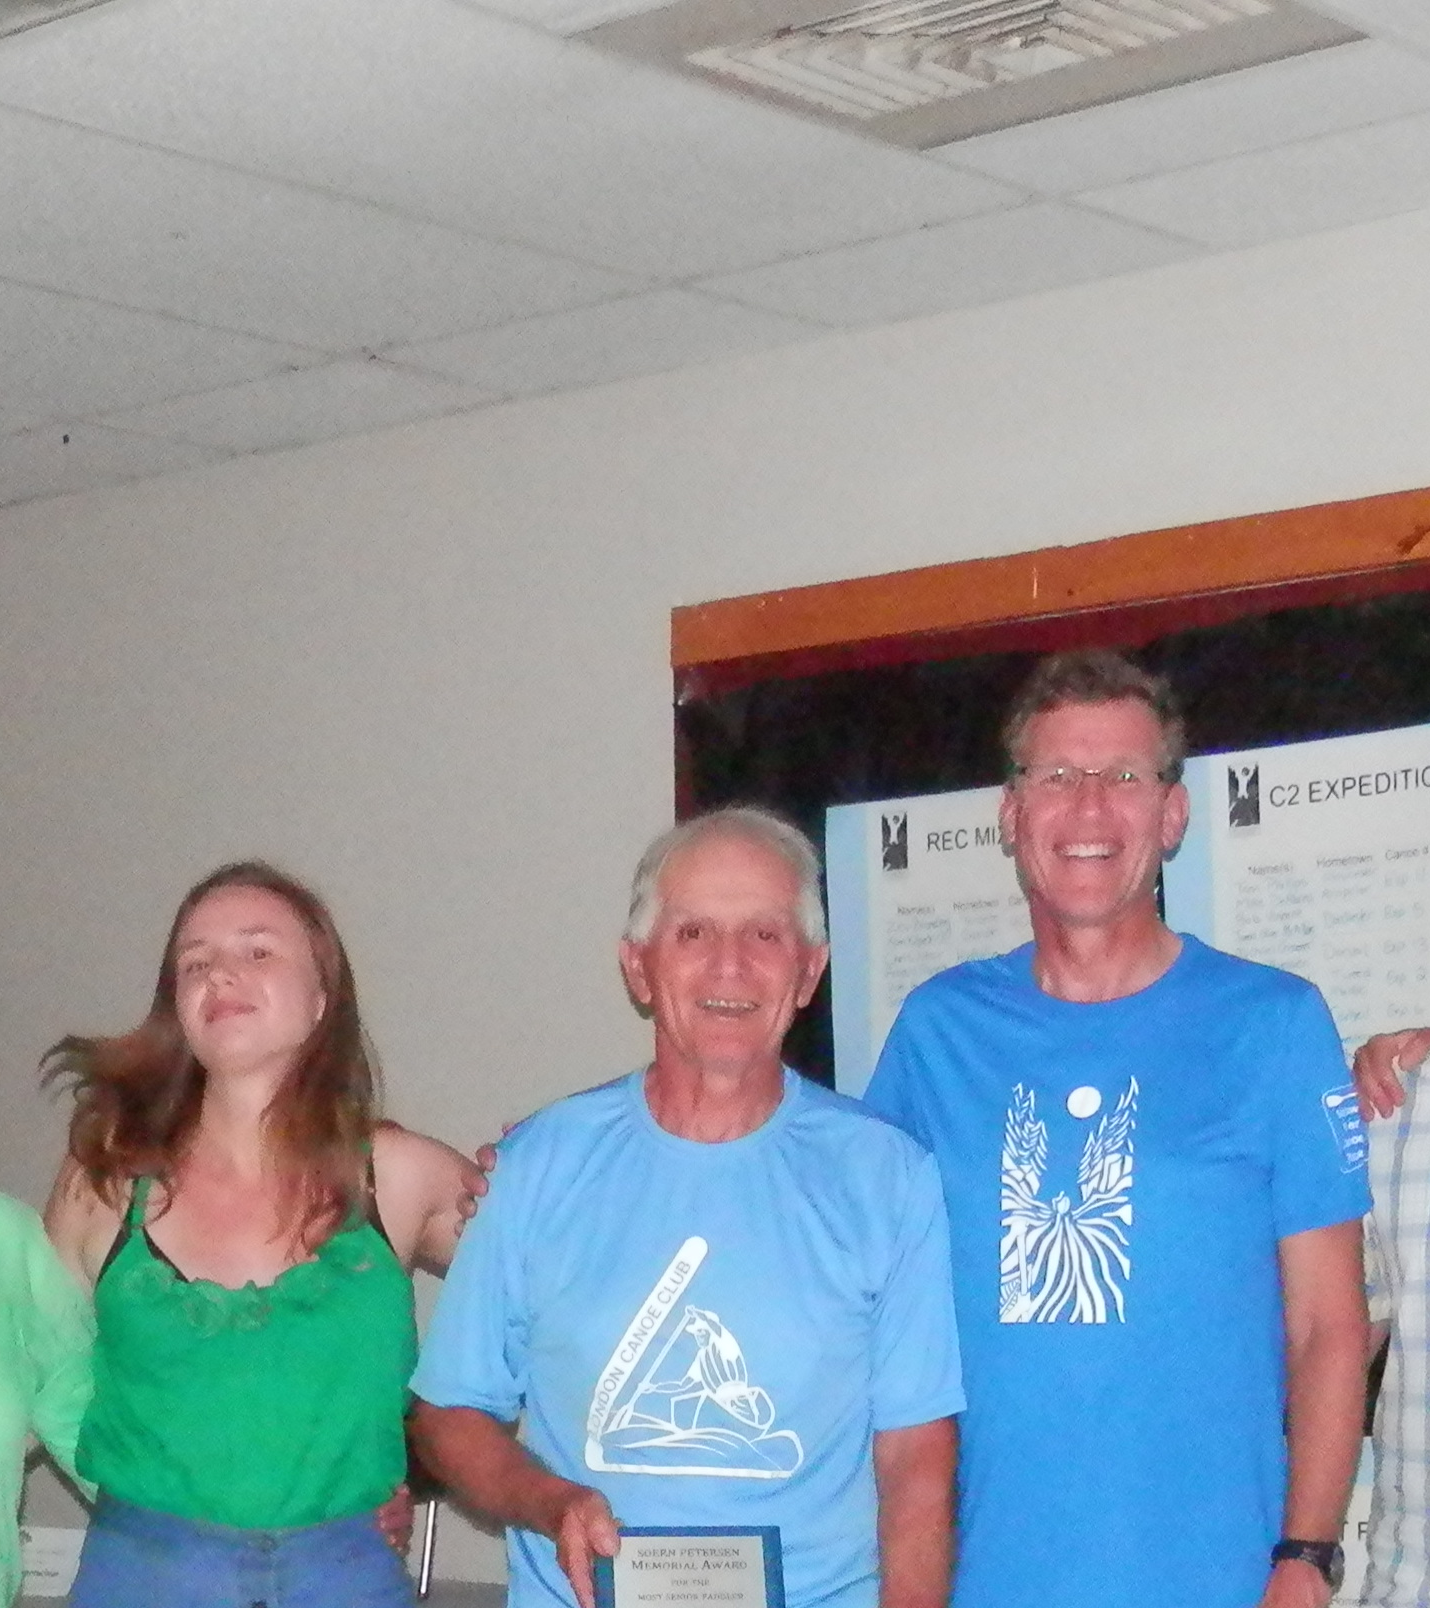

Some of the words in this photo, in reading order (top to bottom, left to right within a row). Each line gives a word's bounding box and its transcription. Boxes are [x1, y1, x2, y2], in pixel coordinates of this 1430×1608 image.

[1269, 782, 1301, 809] C2
[927, 829, 969, 852] REC
[620, 1305, 663, 1366] CANOE
[656, 1259, 693, 1306] CLUB
